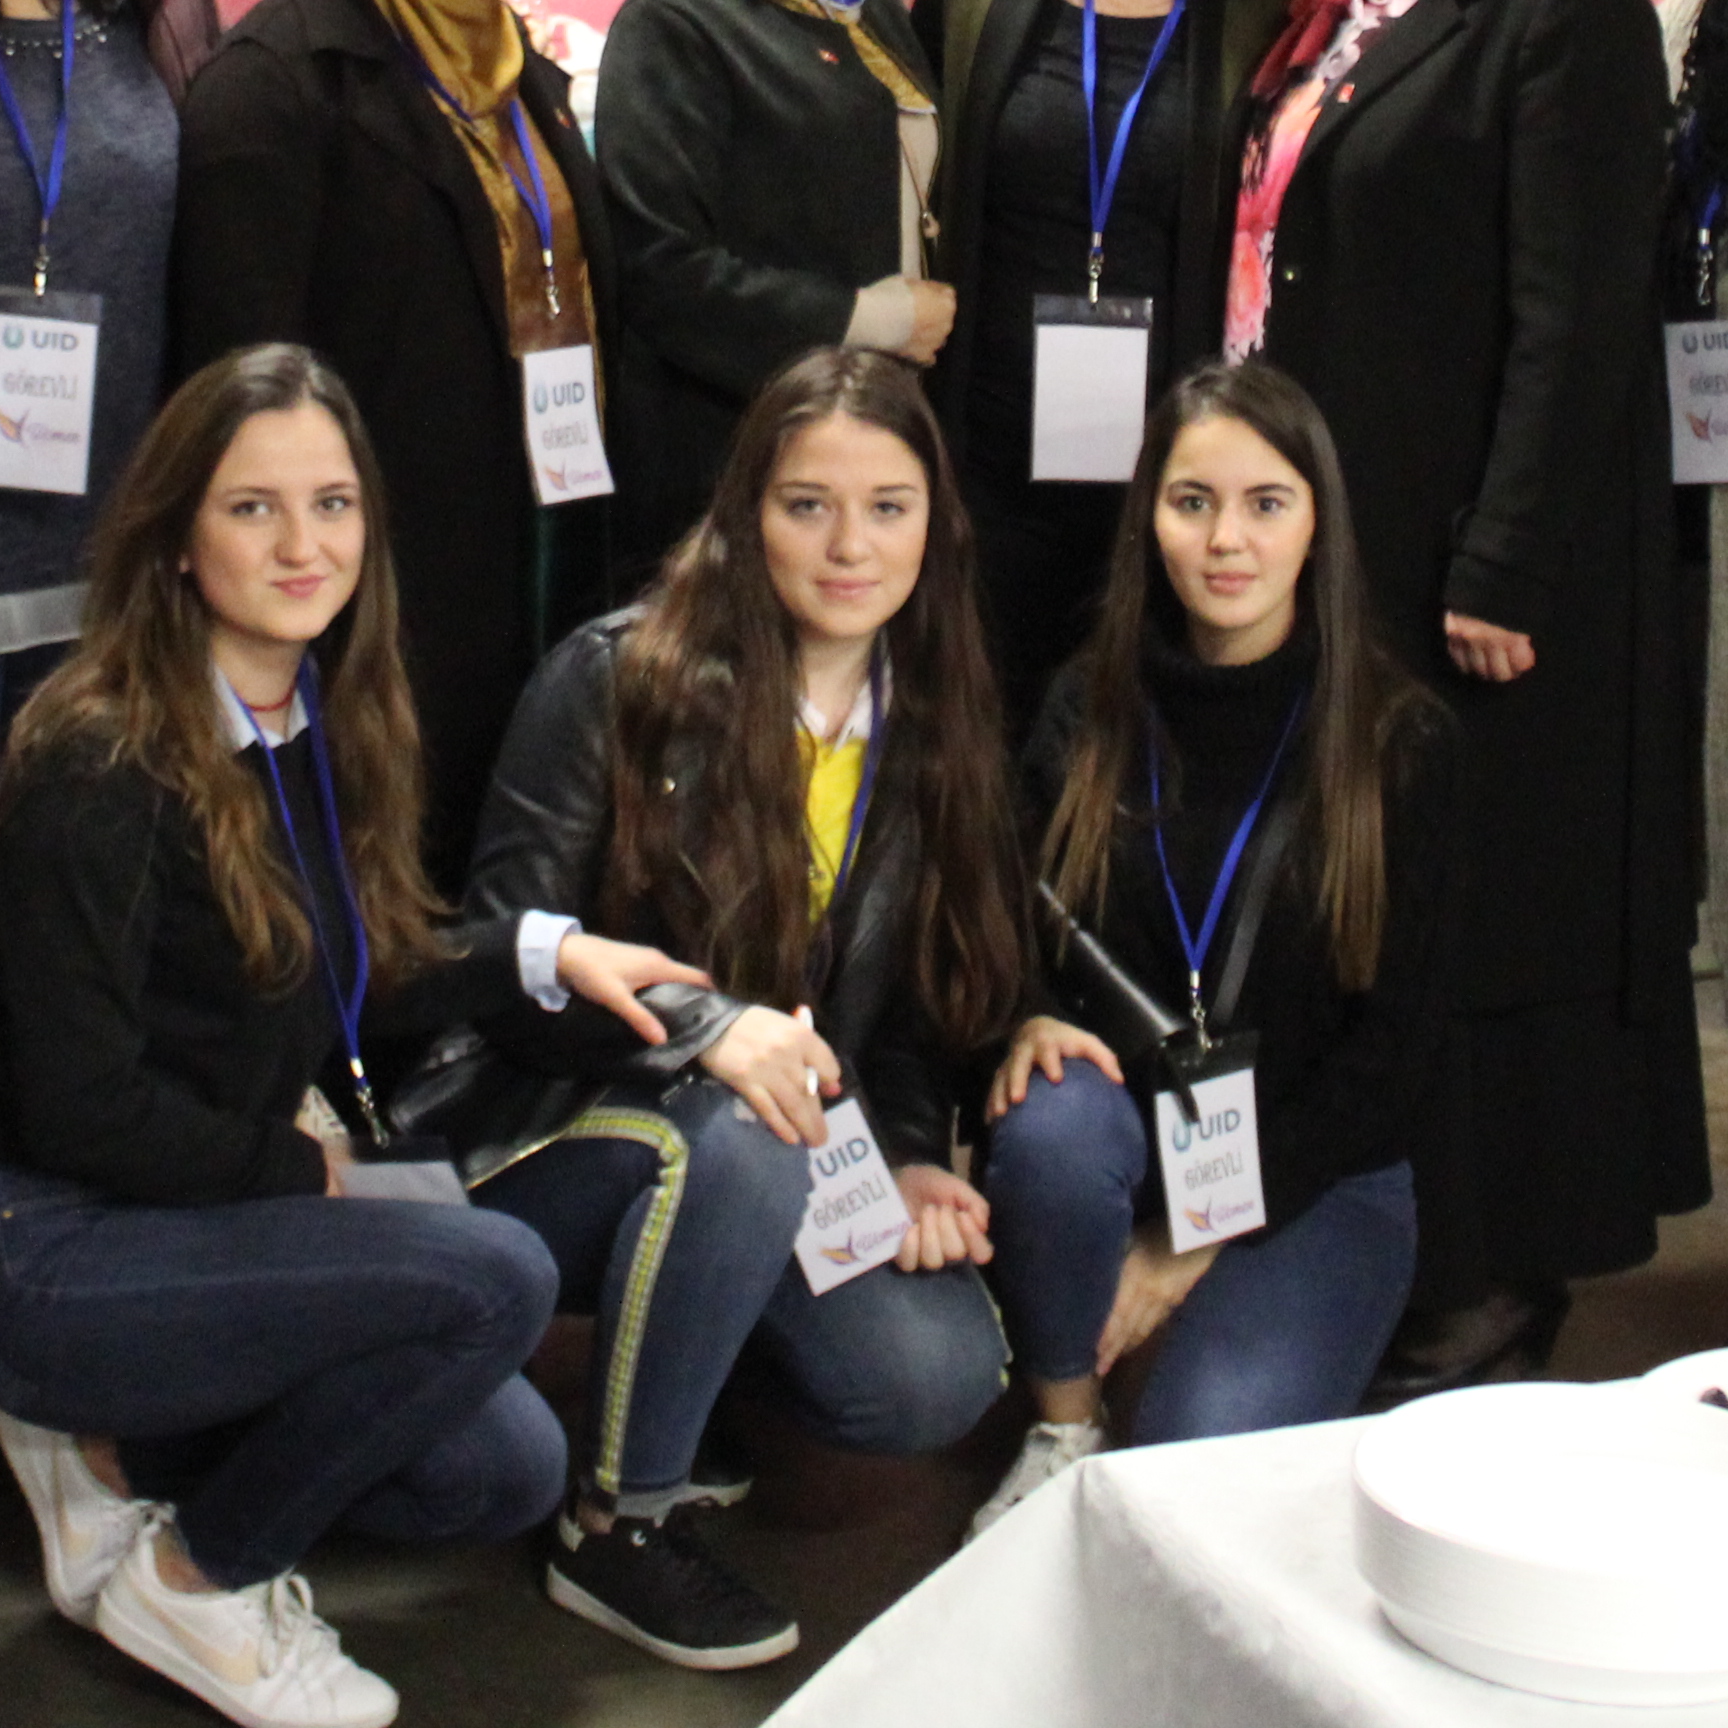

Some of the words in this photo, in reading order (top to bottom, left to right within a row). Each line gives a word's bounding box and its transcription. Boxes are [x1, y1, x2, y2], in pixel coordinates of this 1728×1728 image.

[32, 330, 79, 351] UID
[553, 382, 584, 407] UID
[1199, 1109, 1241, 1140] UID
[817, 1138, 870, 1177] UID
